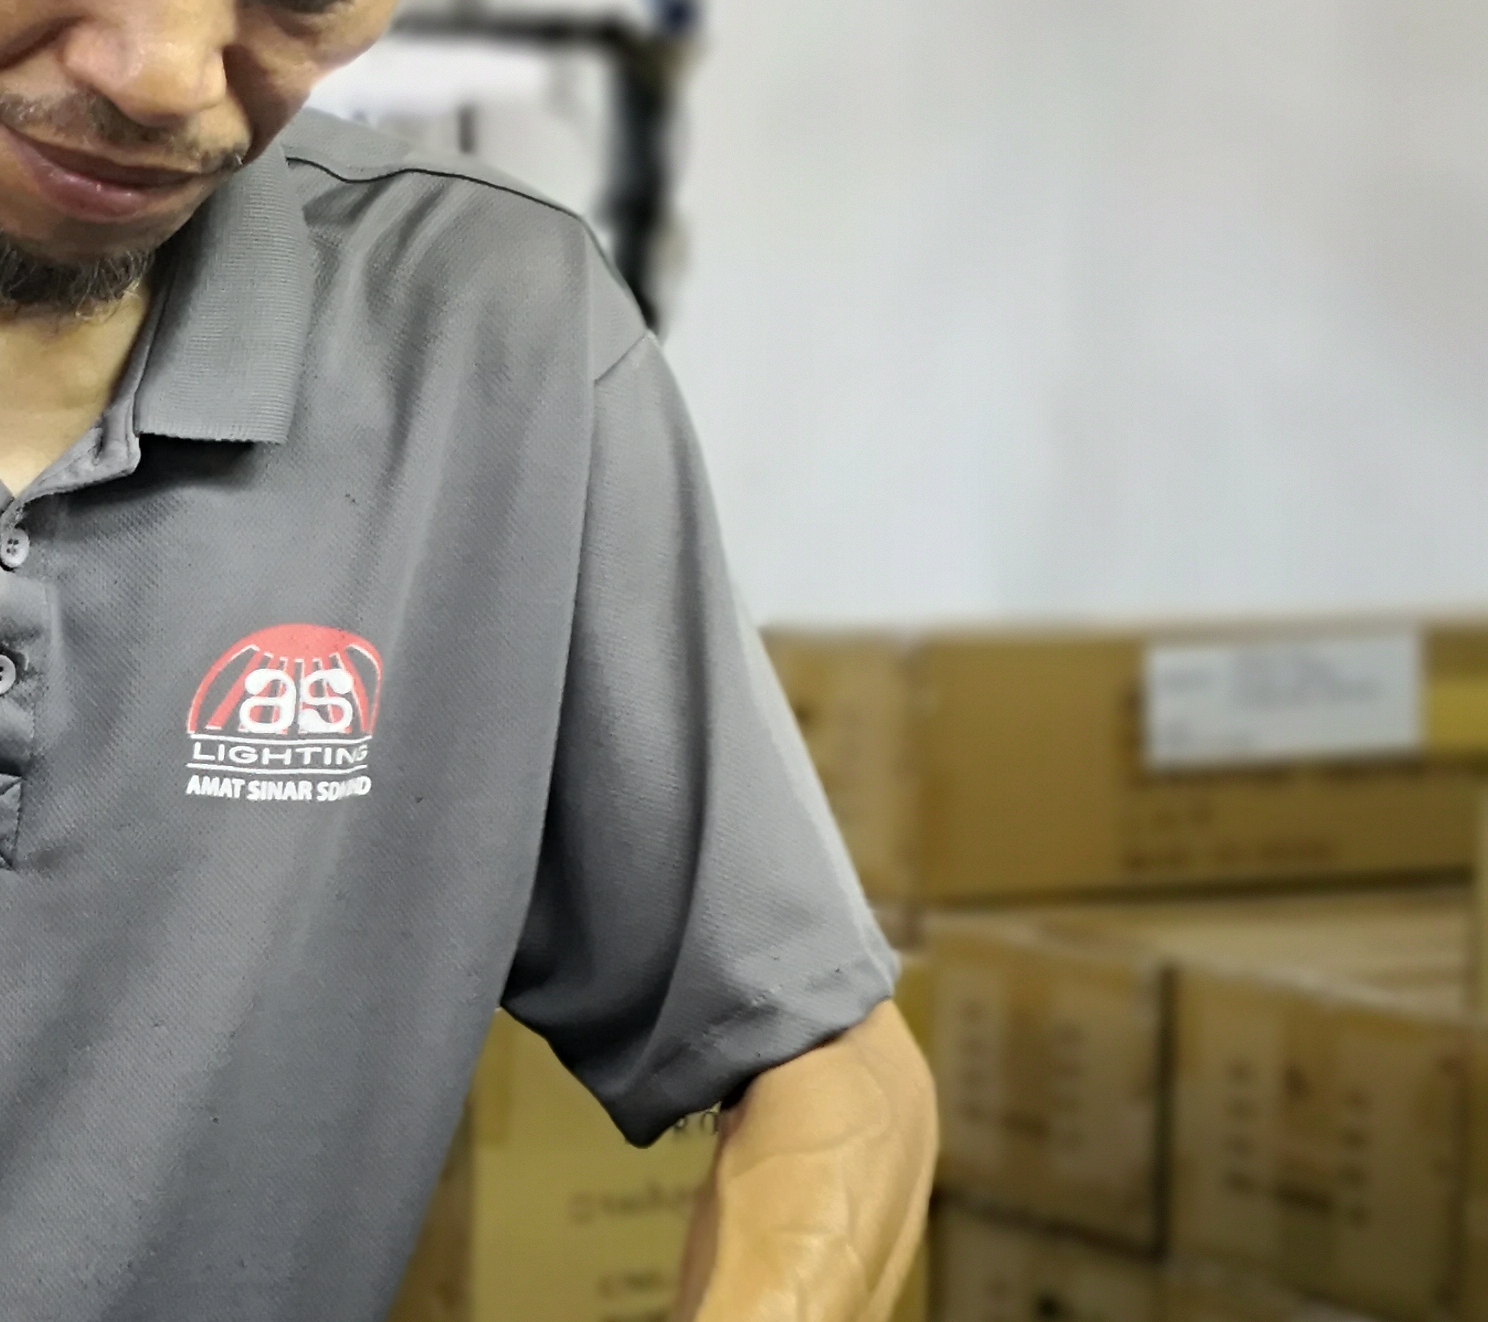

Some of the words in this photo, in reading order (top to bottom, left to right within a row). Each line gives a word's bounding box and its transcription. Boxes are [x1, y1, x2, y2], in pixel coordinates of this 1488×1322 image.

[239, 668, 354, 733] as
[192, 741, 368, 765] LIGHTING
[185, 775, 245, 798] AMAT
[246, 779, 313, 801] SINAR
